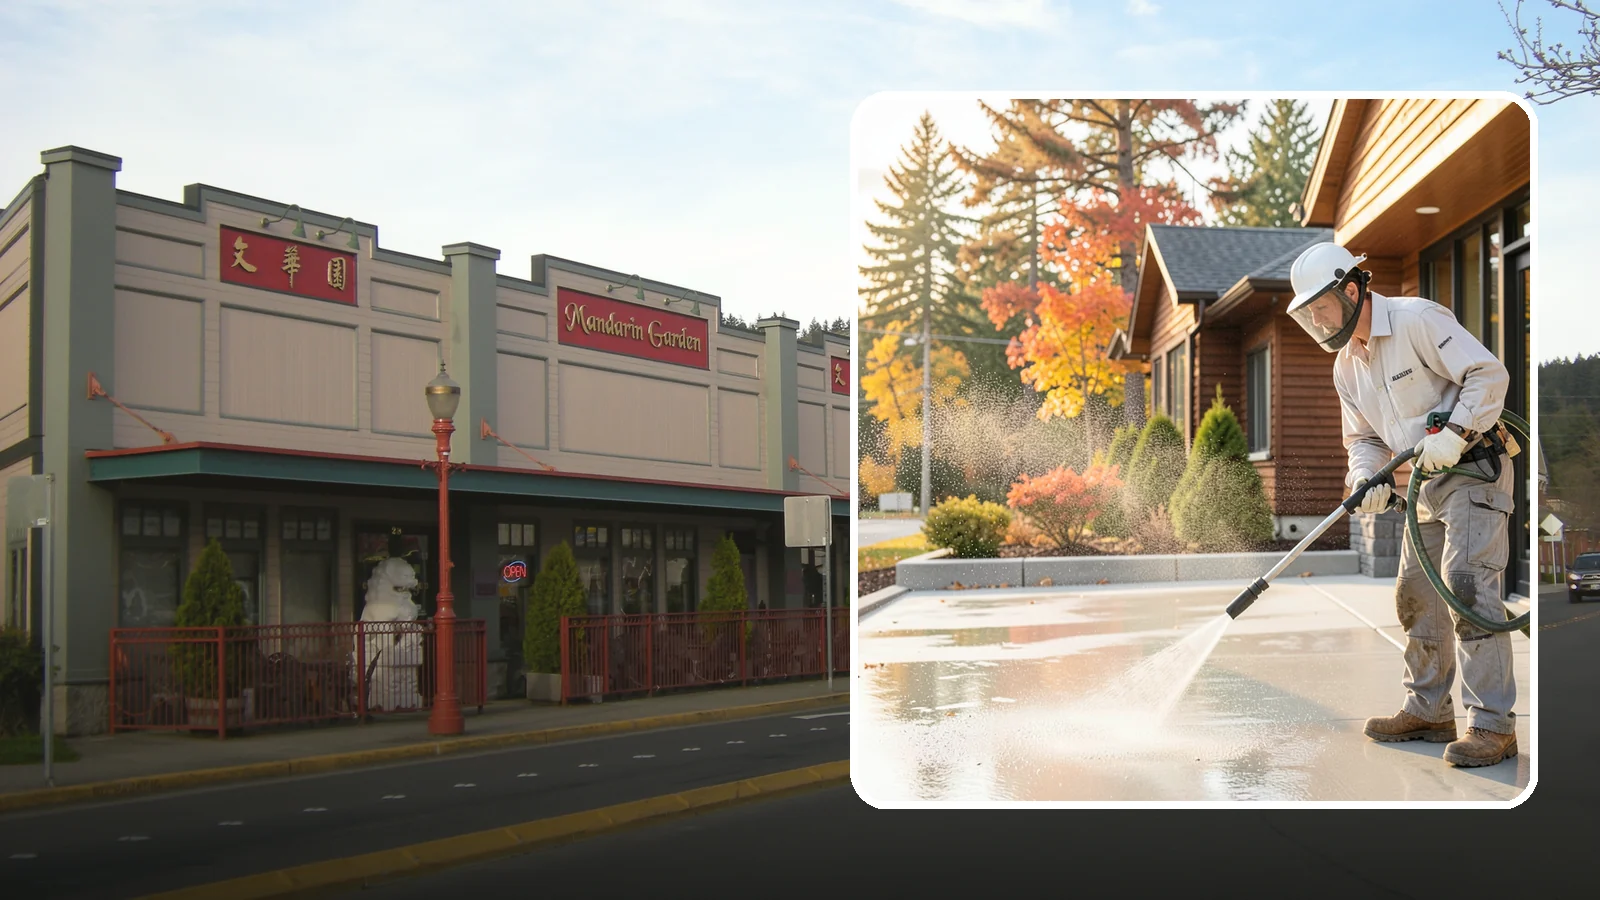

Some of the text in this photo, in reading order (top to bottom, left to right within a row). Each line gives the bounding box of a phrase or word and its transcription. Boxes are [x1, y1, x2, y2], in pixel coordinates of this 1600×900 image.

[230, 235, 346, 291] 文華園
[564, 302, 701, 352] Mandarin Garden
[503, 565, 527, 578] OPEN
